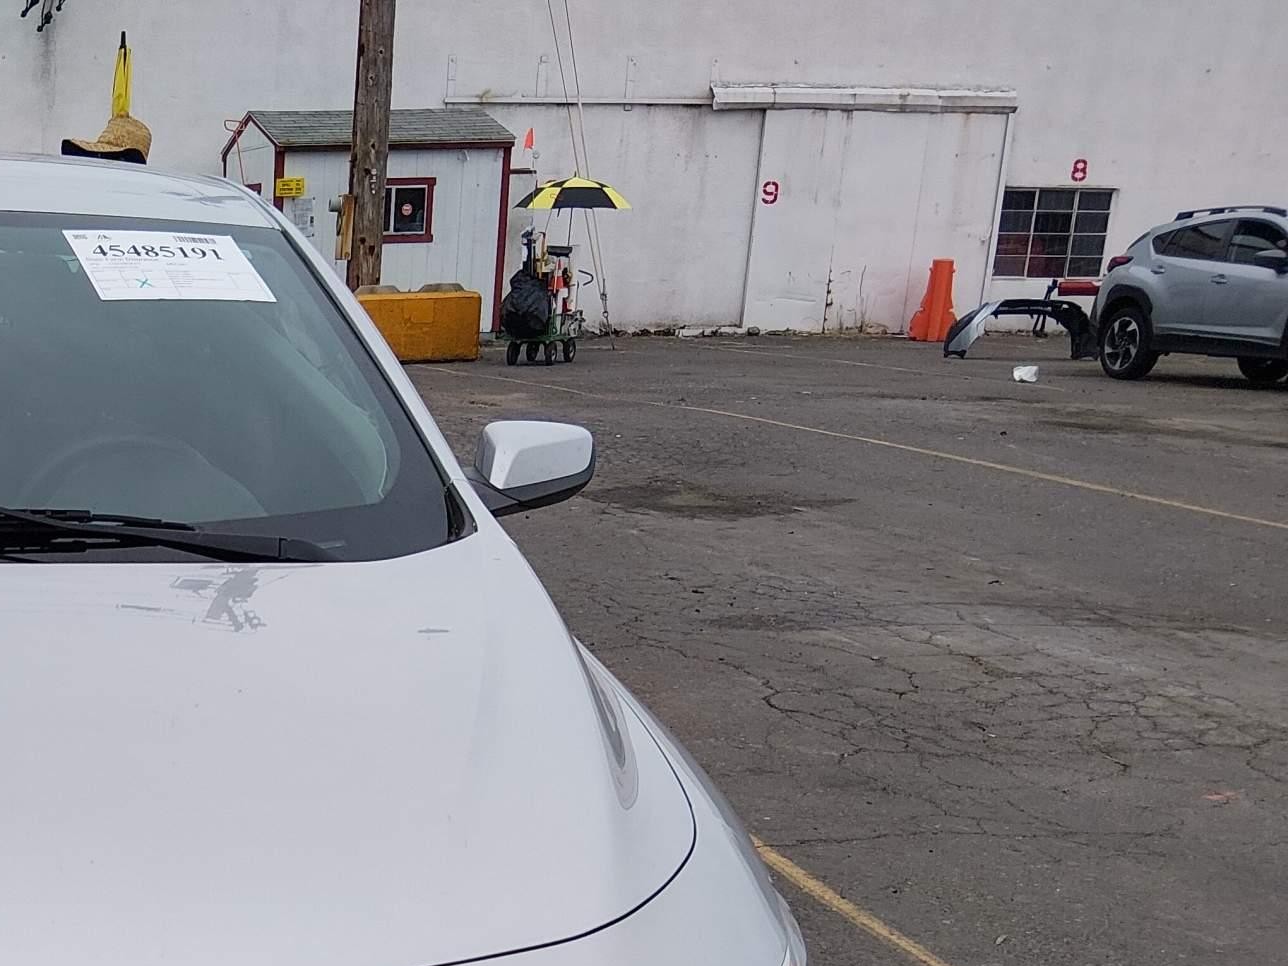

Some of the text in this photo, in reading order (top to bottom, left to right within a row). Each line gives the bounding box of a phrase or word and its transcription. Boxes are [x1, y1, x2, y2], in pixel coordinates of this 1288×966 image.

[1070, 158, 1088, 182] 8
[761, 181, 779, 205] 9
[92, 244, 224, 260] 45485191
